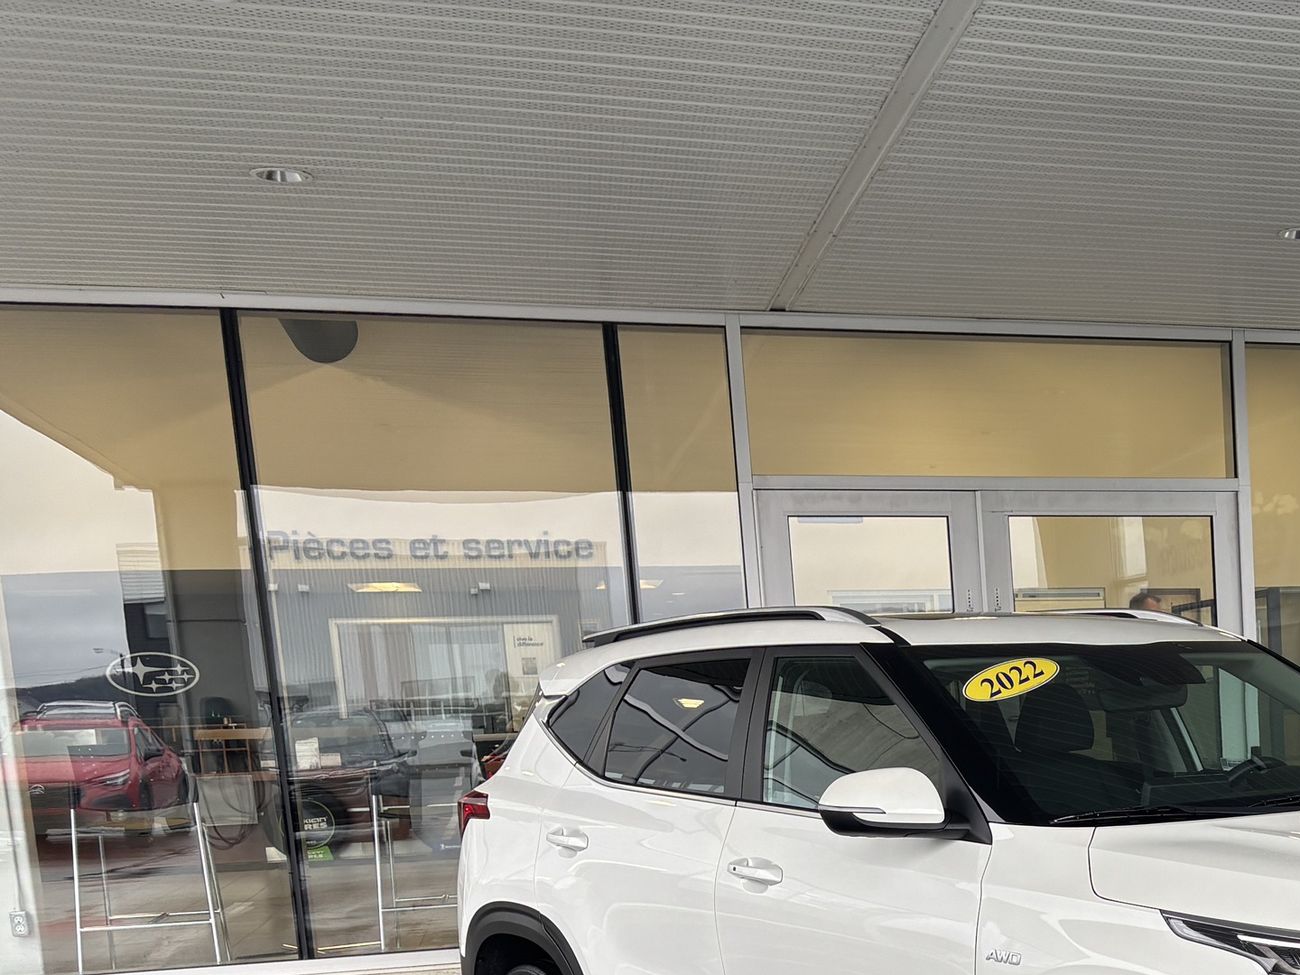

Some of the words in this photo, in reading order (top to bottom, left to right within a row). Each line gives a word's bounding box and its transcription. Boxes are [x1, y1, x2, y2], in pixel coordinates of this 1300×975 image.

[266, 530, 394, 561] Pièces
[410, 534, 449, 560] et
[462, 530, 595, 560] service
[980, 660, 1045, 698] 2022
[985, 948, 1022, 966] AWD
